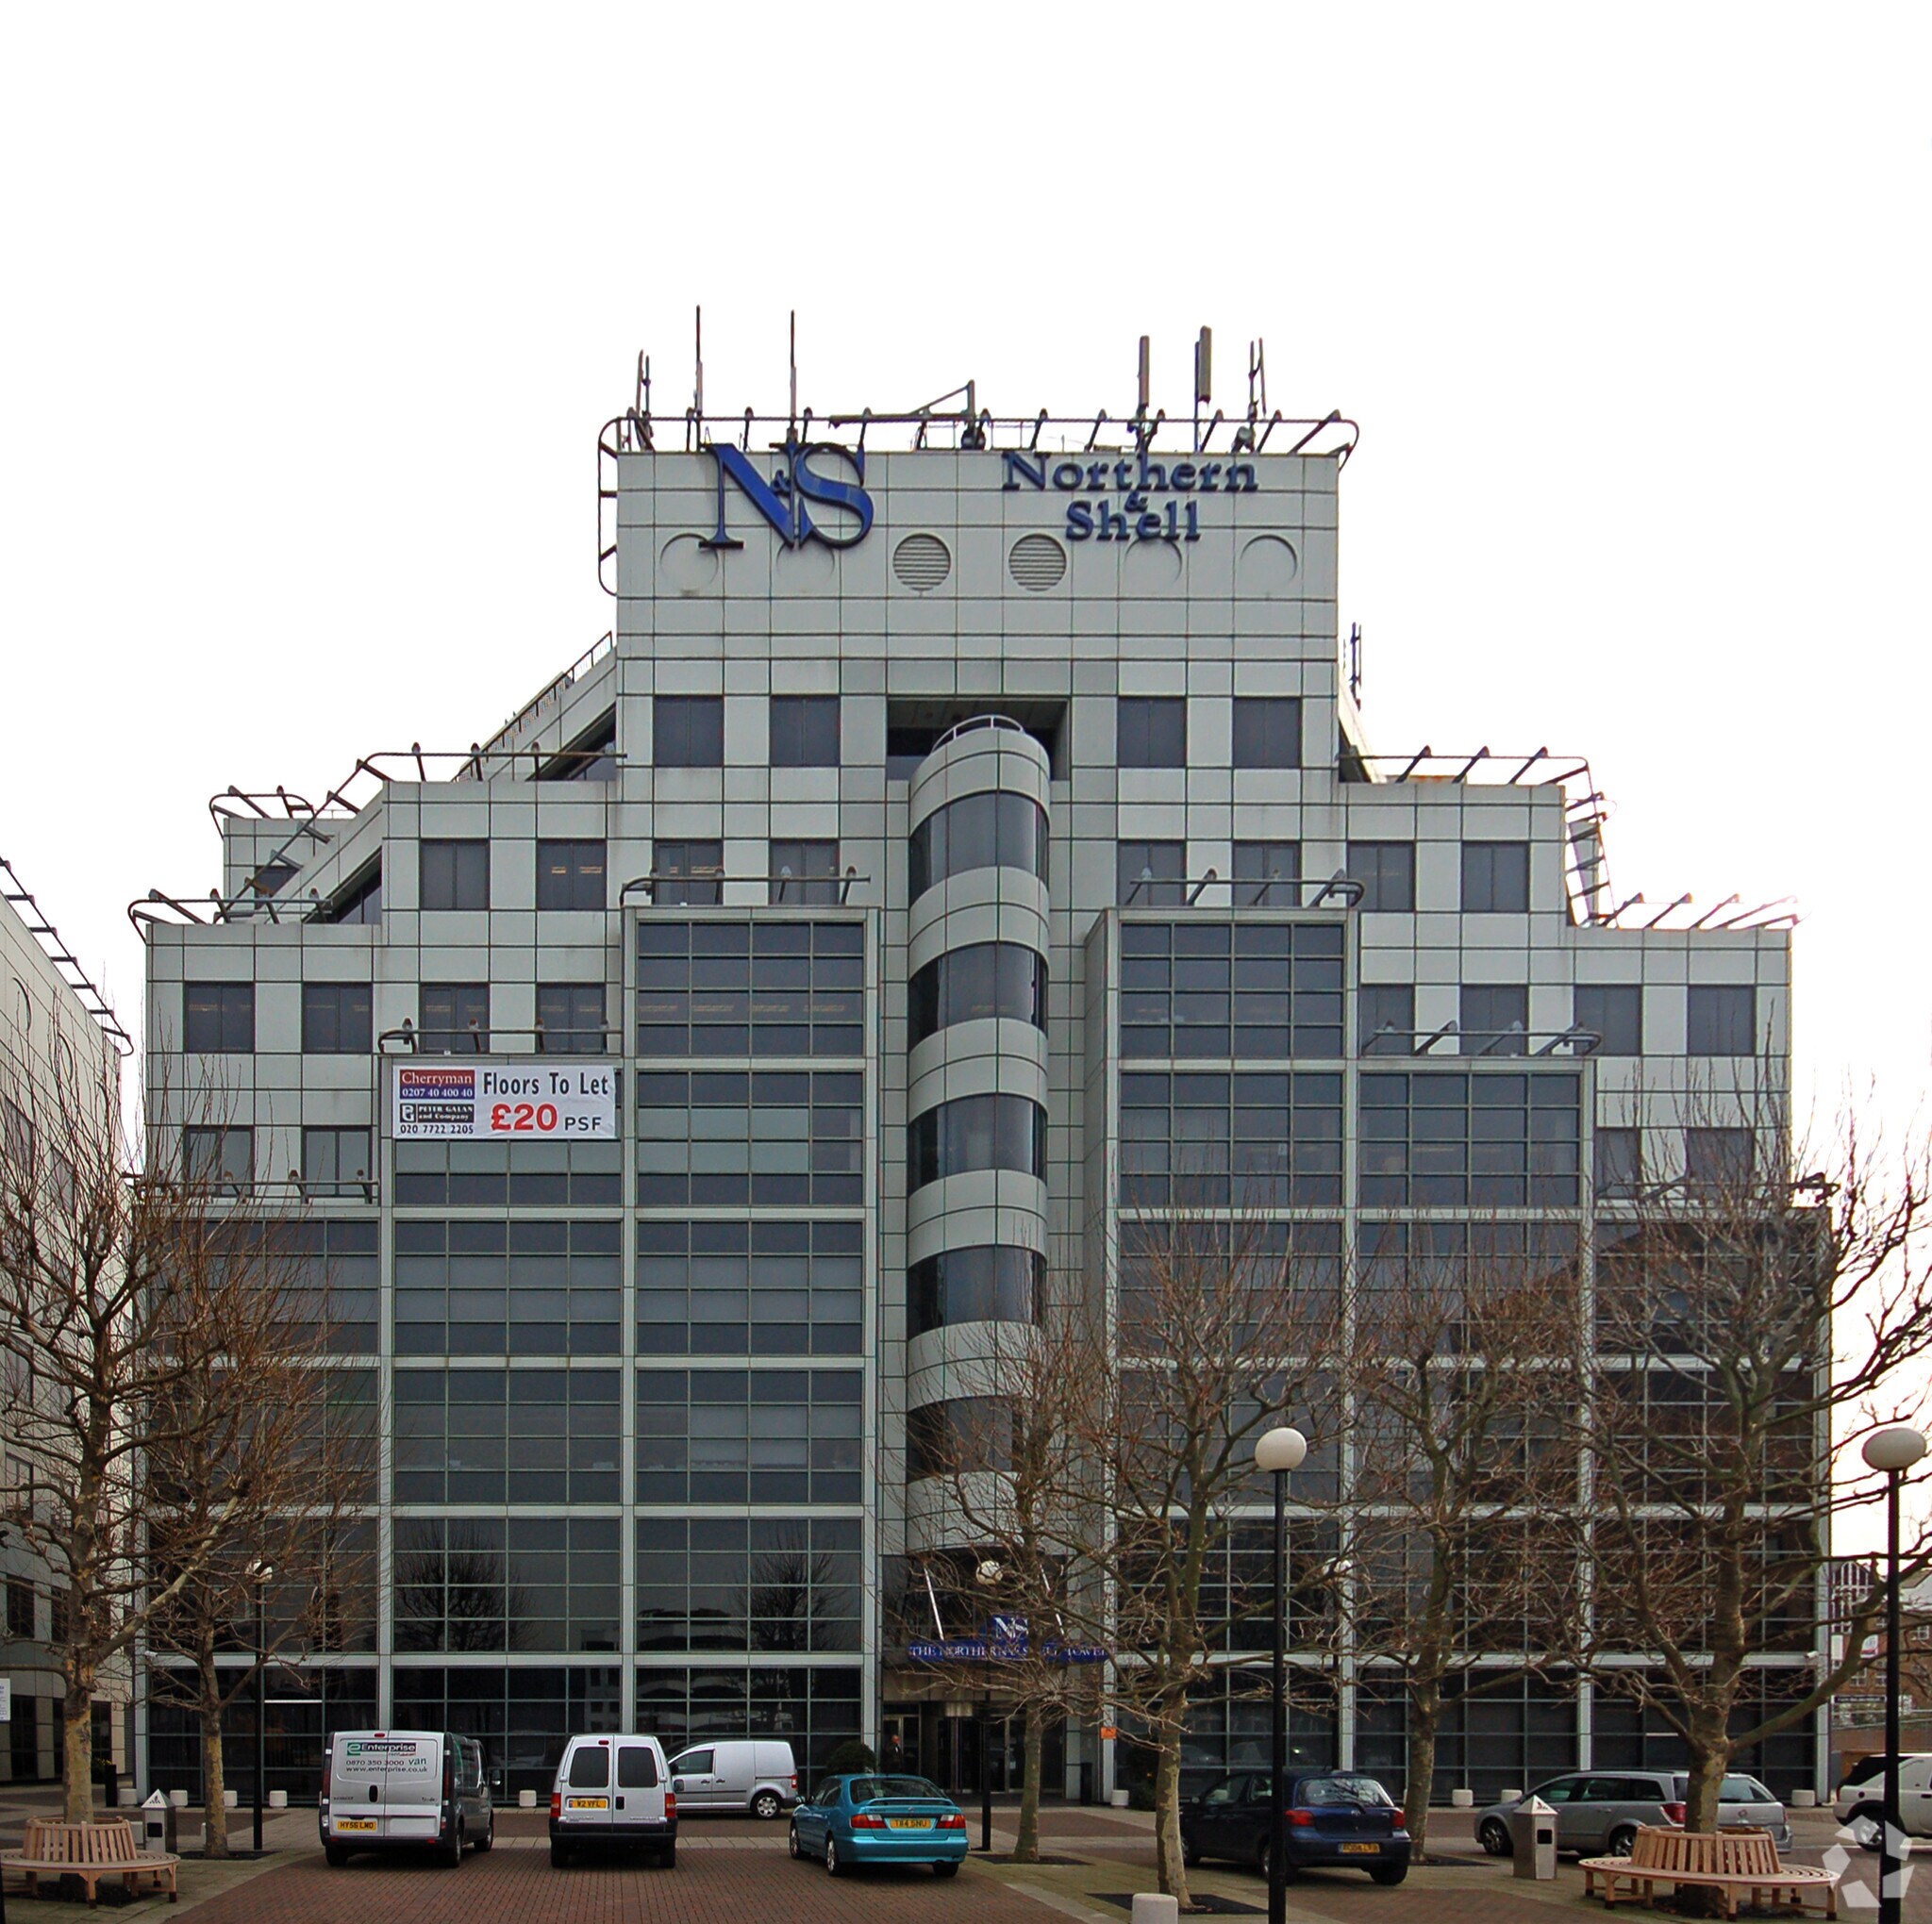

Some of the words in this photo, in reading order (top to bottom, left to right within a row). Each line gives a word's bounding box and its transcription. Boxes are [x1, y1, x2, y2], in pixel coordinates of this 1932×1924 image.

[1001, 451, 1259, 490] Northern
[1124, 489, 1148, 512] &
[1065, 499, 1201, 541] Shell
[402, 1071, 473, 1087] Cherryman
[483, 1071, 540, 1095] Floors
[549, 1071, 570, 1095] To
[579, 1071, 608, 1095] Let
[402, 1087, 425, 1097] 0207
[427, 1087, 440, 1097] 40
[441, 1087, 459, 1097] 400
[460, 1087, 473, 1097] 40
[491, 1103, 558, 1131] £20
[564, 1117, 602, 1131] PSF
[400, 1124, 418, 1134] 020
[423, 1124, 445, 1134] 7722
[450, 1124, 474, 1134] 2205
[361, 1744, 415, 1752] Enterprise
